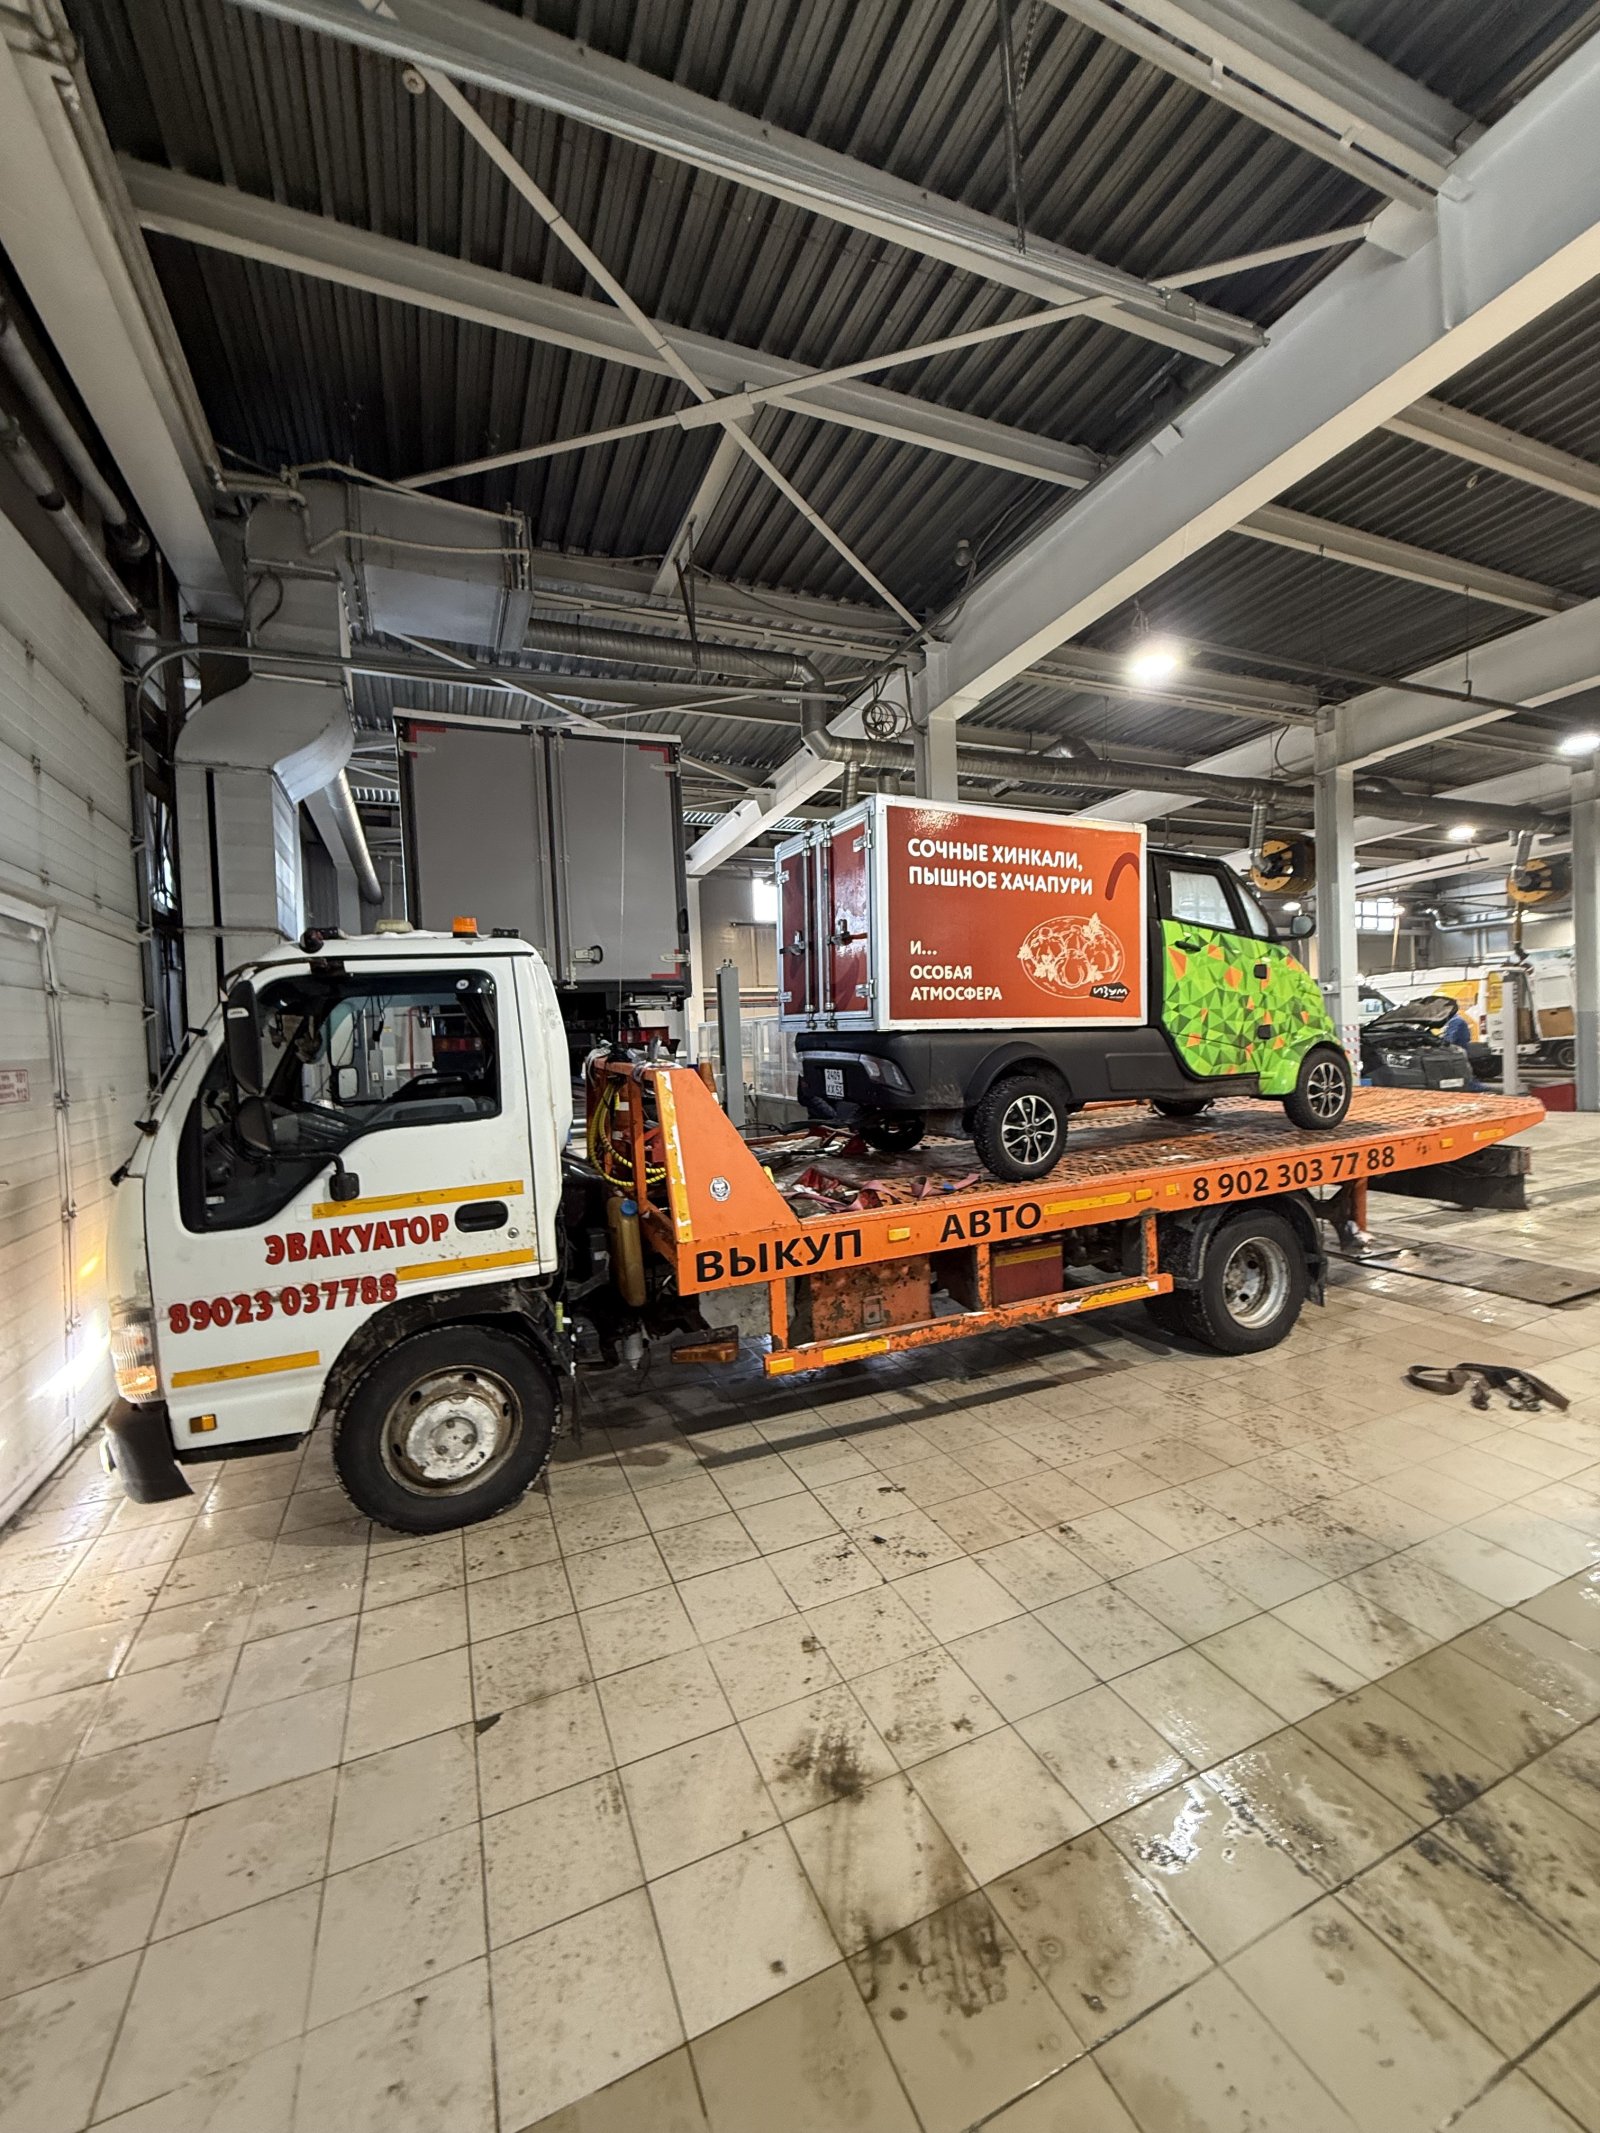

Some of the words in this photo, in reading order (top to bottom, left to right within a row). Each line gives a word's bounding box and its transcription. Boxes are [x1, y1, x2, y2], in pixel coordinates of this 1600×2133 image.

[908, 838, 989, 862] СОЧНЫЕ
[992, 845, 1083, 872] ХИНКАЛИ,
[909, 866, 997, 889] ПЫШНОЕ
[1000, 872, 1093, 895] ХАЧАПУРИ
[910, 940, 938, 955] И...
[910, 965, 973, 979] ОСОБАЯ
[910, 986, 1003, 1001] АТМОСФЕРА
[1192, 1177, 1210, 1201] 8
[1217, 1168, 1269, 1198] 902
[1277, 1158, 1323, 1188] 303
[1331, 1152, 1359, 1178] 77
[1367, 1145, 1395, 1170] 88
[264, 1213, 449, 1266] ЭВАКУАТОР
[695, 1229, 862, 1283] ВЫКУП
[940, 1202, 1042, 1243] АВТО
